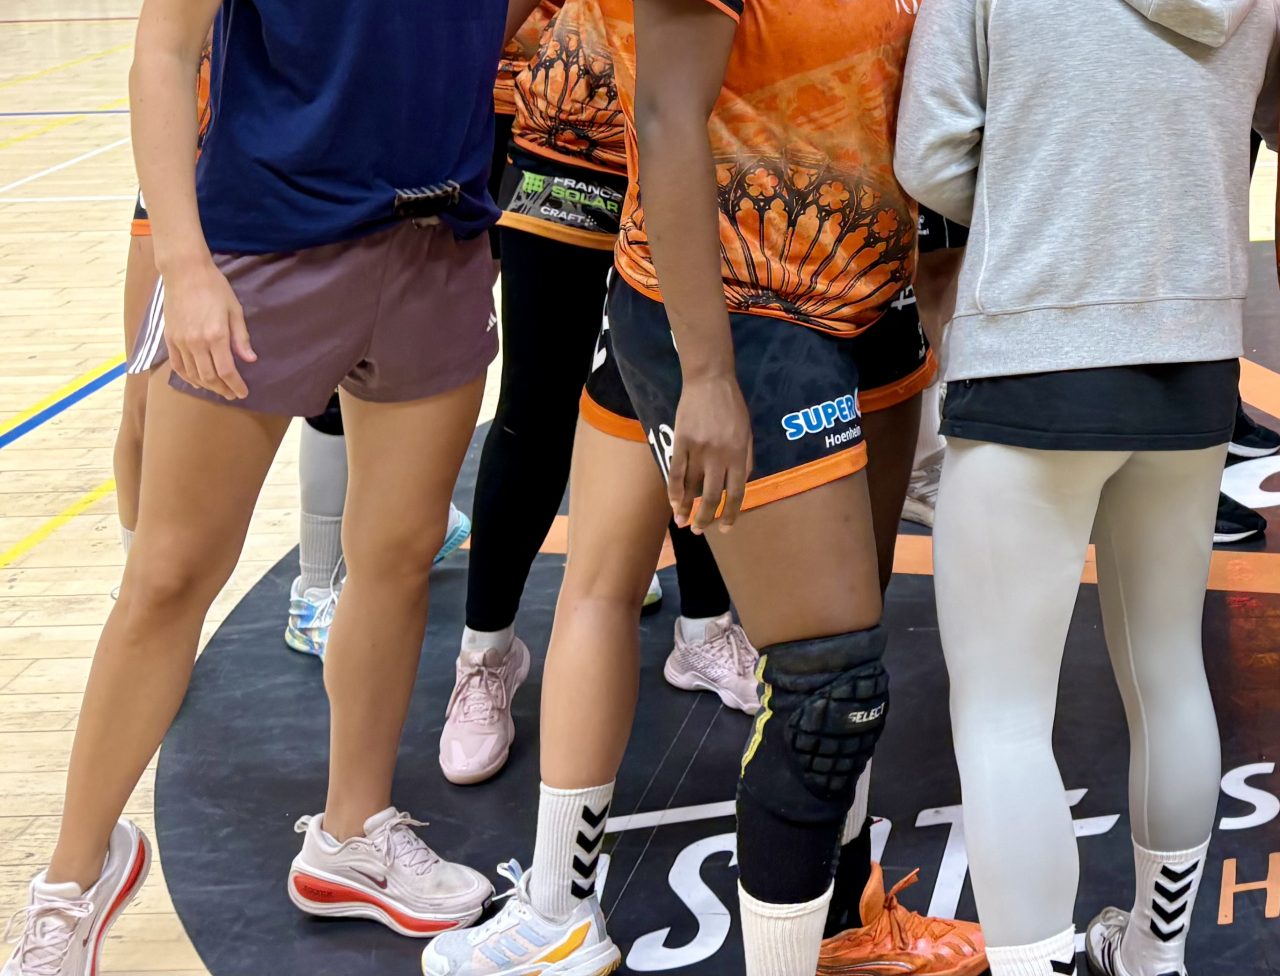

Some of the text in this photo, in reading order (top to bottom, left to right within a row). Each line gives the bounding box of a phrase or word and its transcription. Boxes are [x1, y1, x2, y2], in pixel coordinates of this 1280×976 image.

[551, 185, 619, 213] SOLAR
[540, 206, 586, 224] CRAFT
[848, 702, 885, 723] SELECT
